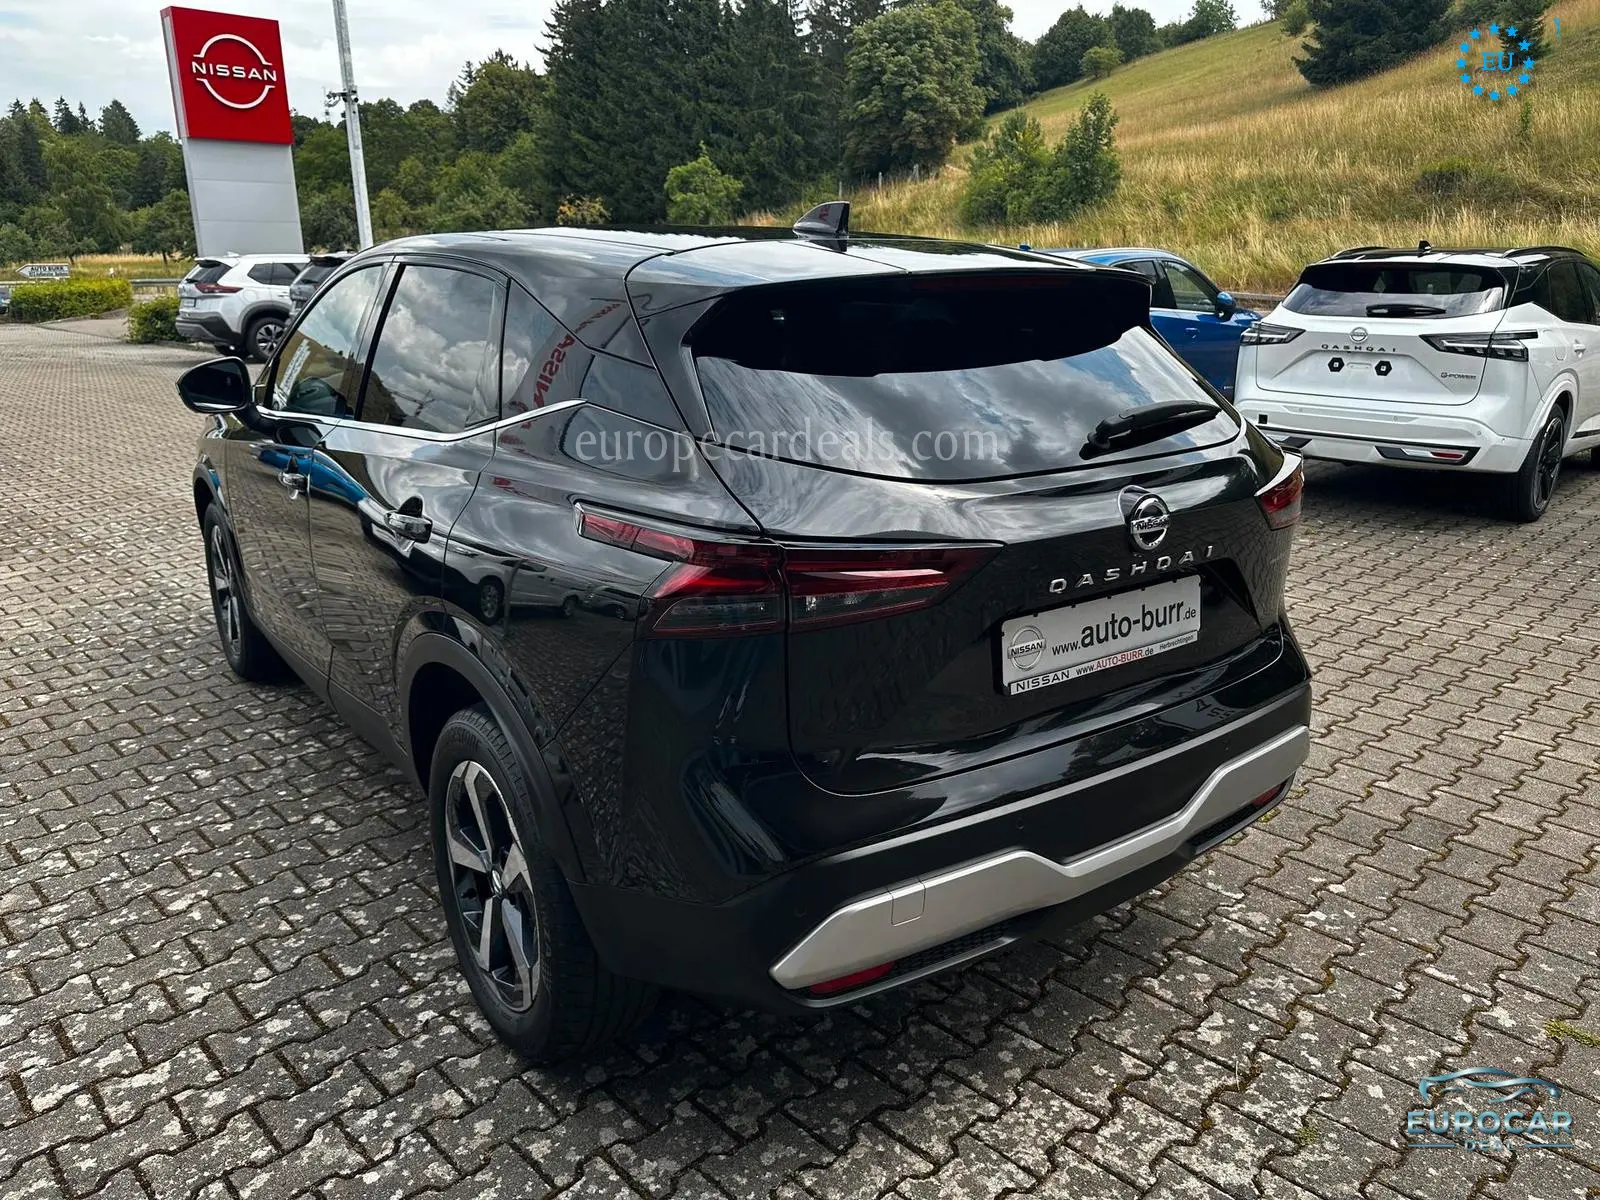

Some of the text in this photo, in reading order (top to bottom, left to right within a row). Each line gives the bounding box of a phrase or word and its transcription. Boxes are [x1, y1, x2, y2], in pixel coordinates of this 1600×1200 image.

[191, 61, 277, 82] NISSAN
[1321, 343, 1396, 352] QASHQAI
[1049, 545, 1214, 594] QASHQAI
[1051, 601, 1196, 656] www.auto-burr.de
[1010, 641, 1043, 656] NISSAN
[1016, 669, 1070, 692] NISSAN
[1075, 647, 1154, 675] www.AUTO-BURR.de
